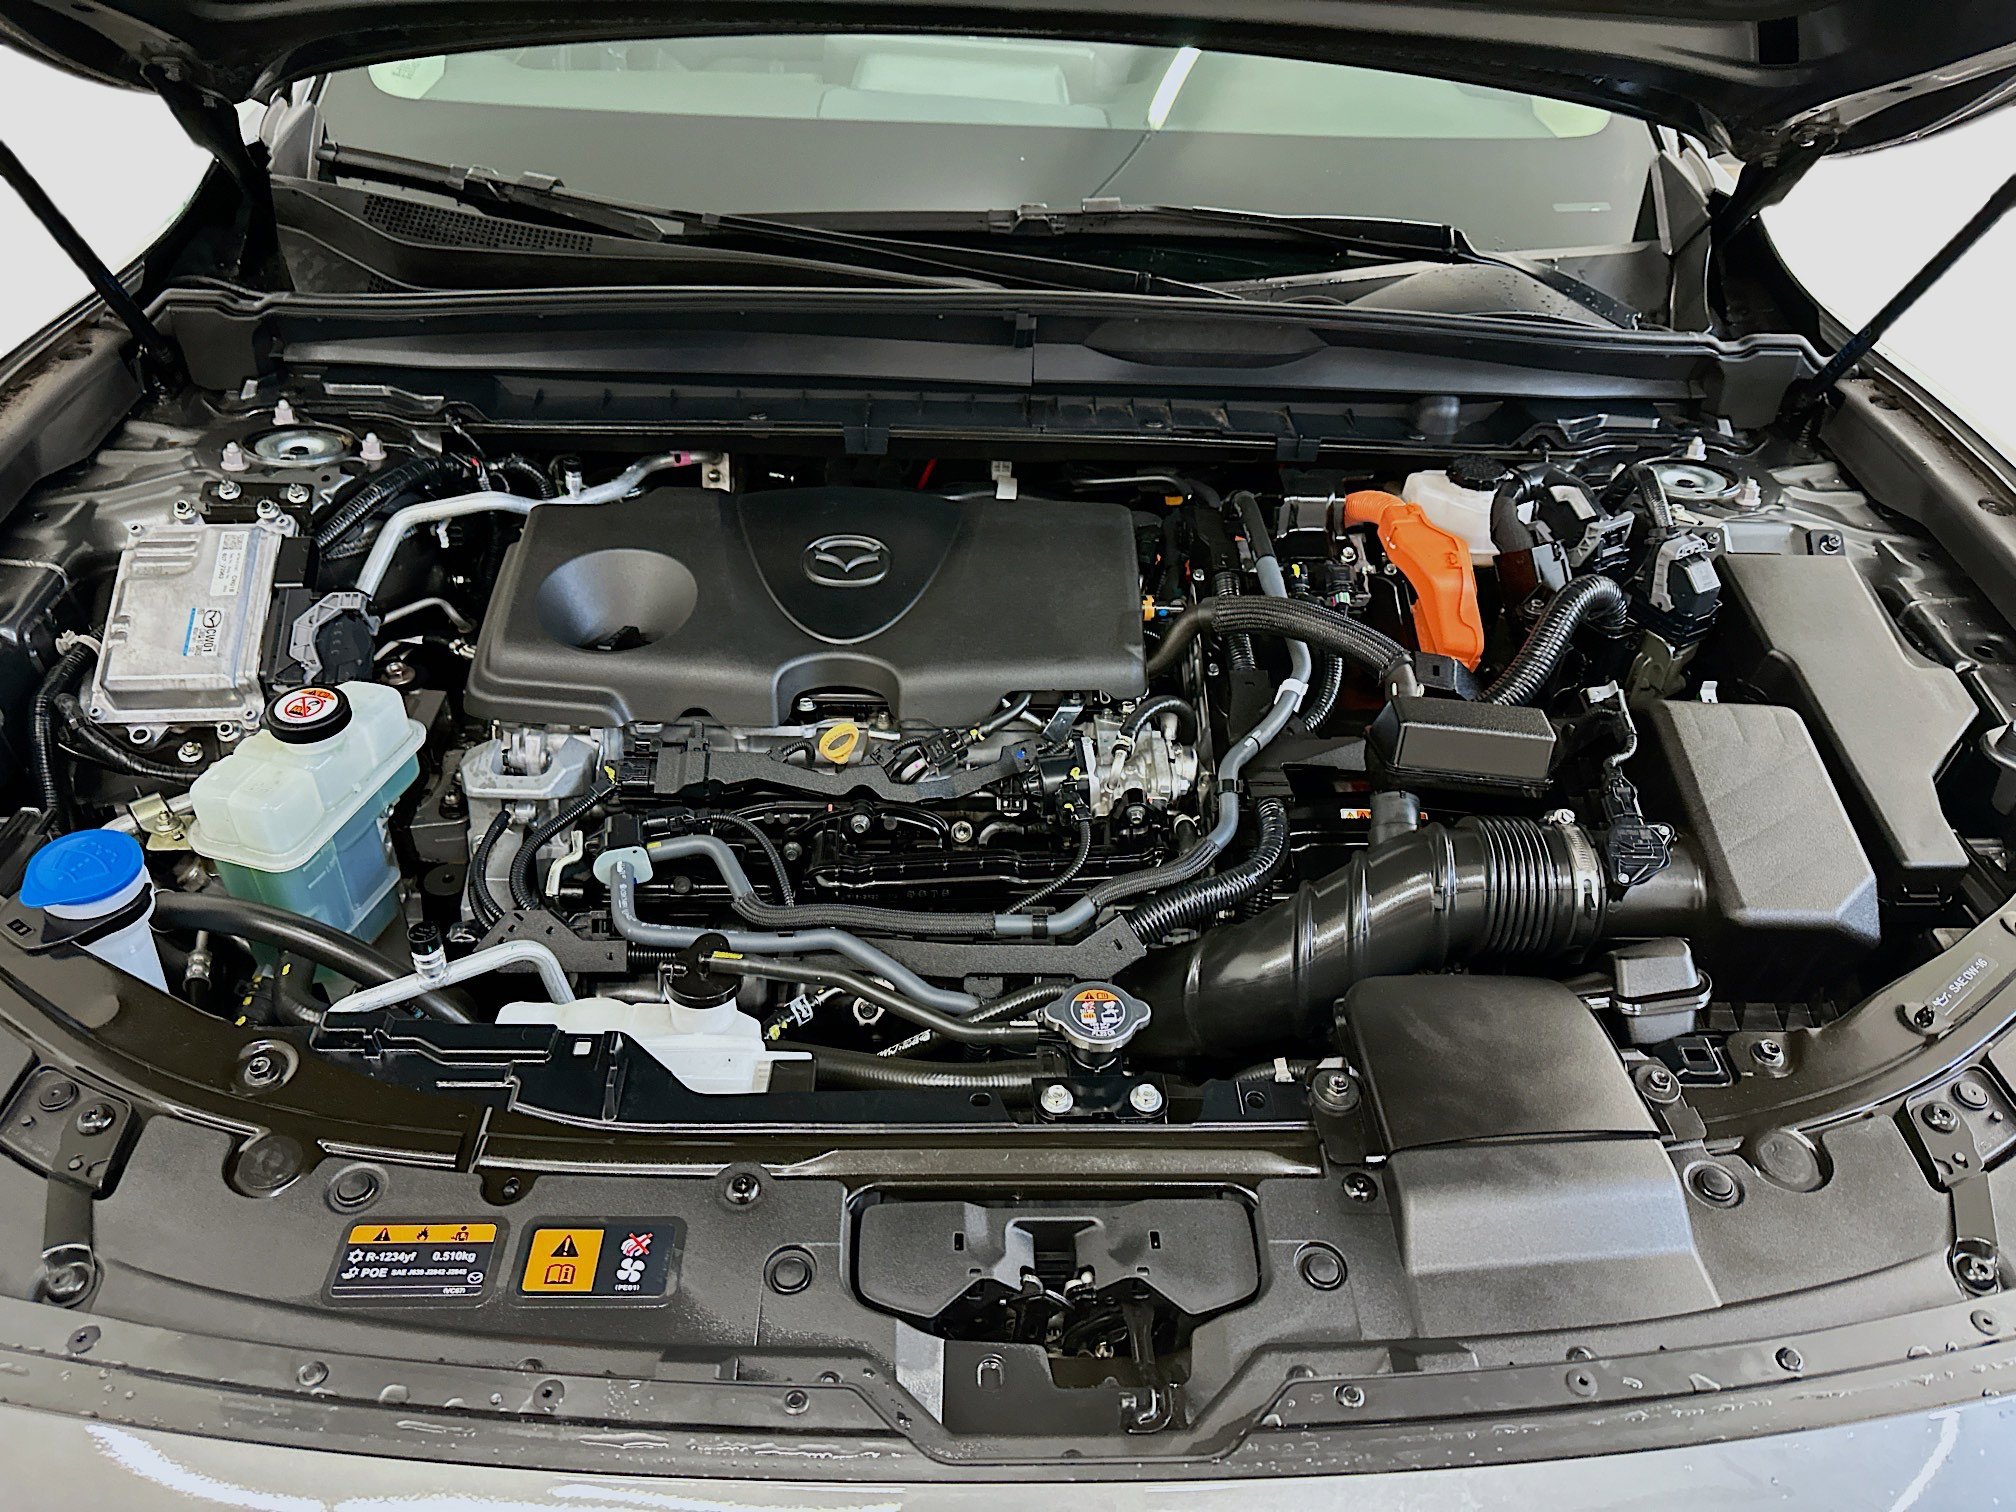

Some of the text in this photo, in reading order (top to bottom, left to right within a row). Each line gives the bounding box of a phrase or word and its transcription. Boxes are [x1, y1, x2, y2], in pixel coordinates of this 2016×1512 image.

[203, 629, 217, 653] CW01
[1949, 958, 1988, 994] SAE 0W-16
[365, 1250, 477, 1263] R-1234yf 0.510kg
[360, 1267, 389, 1278] POE
[391, 1268, 407, 1276] SAE
